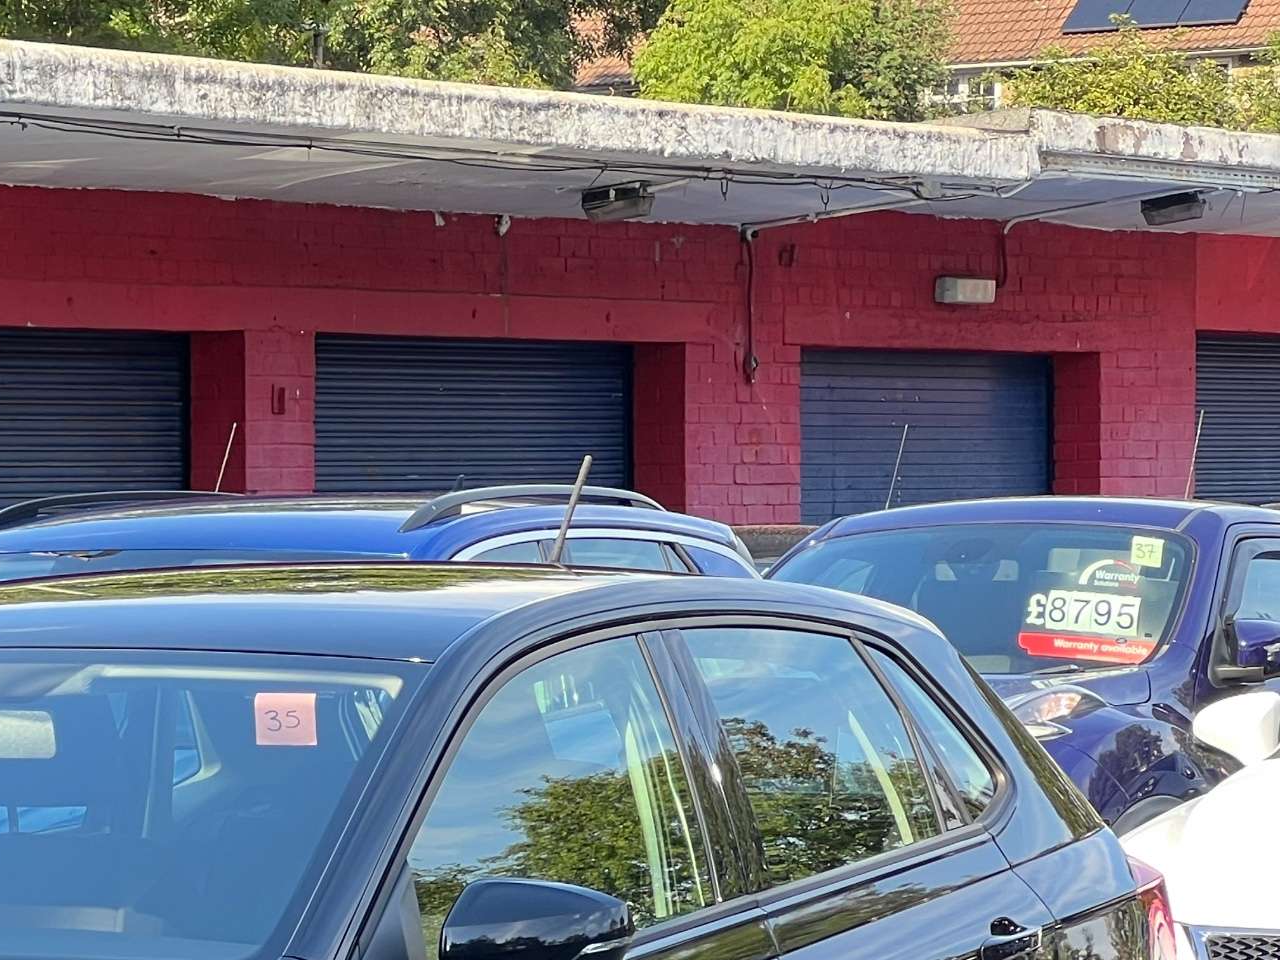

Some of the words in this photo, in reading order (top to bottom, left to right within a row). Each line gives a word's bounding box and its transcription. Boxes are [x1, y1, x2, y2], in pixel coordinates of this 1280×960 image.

[1135, 543, 1157, 560] 37
[1095, 569, 1140, 584] Warranty
[1025, 593, 1136, 630] £8795
[1053, 638, 1099, 653] Warranty
[1100, 644, 1148, 655] available
[264, 709, 301, 732] 35
